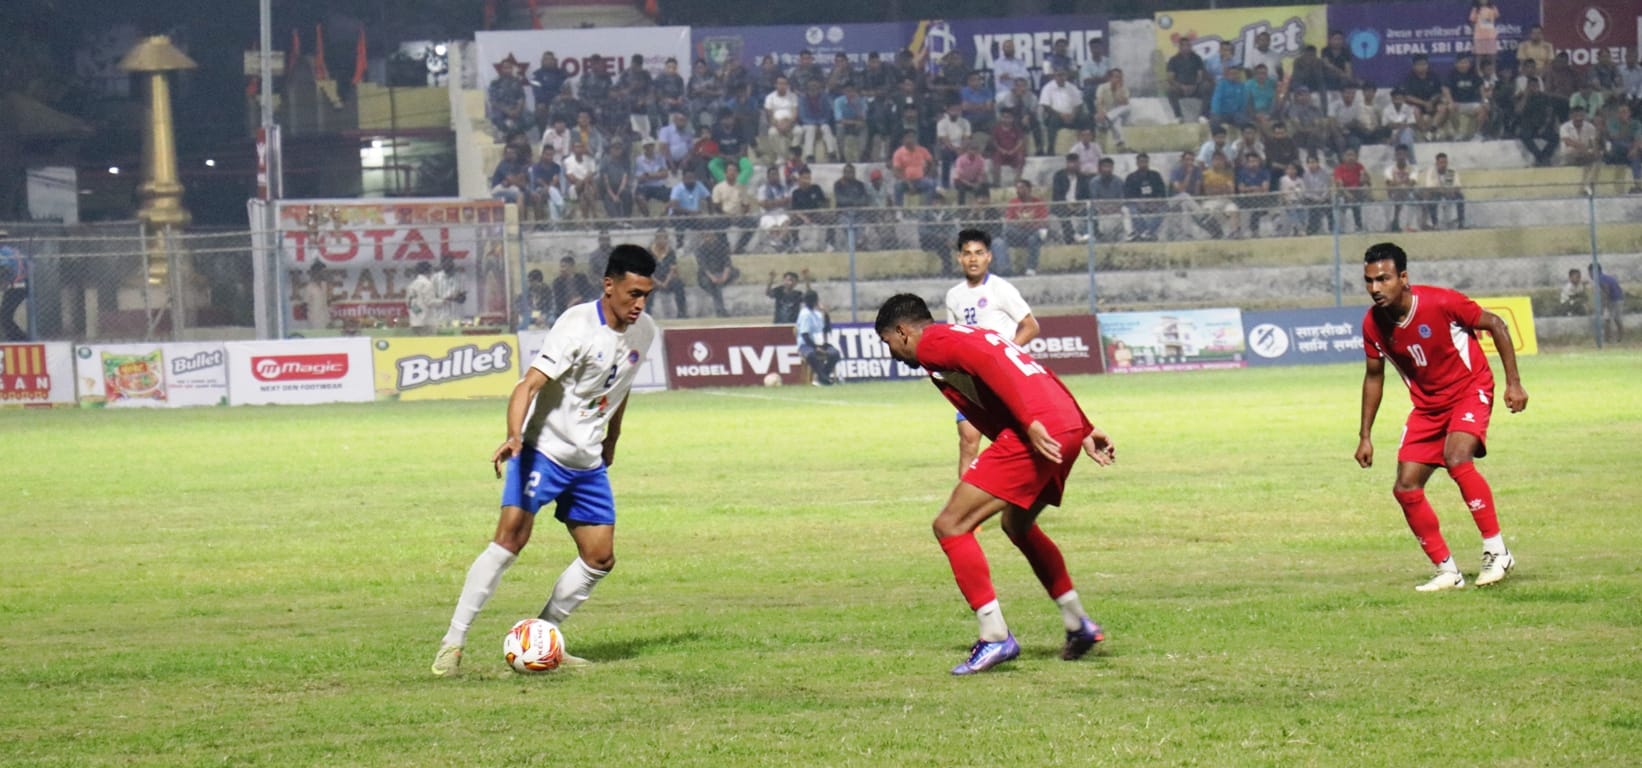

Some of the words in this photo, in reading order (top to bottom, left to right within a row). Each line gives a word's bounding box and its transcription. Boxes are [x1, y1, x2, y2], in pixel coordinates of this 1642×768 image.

[1191, 21, 1303, 69] Blet
[1386, 43, 1428, 55] NEPAL
[1431, 42, 1451, 53] SBI
[560, 56, 626, 77] OBEL
[284, 227, 471, 262] TOTAL
[964, 307, 977, 325] 22
[828, 328, 892, 358] XTR
[173, 351, 222, 375] Bullet
[399, 343, 513, 390] Bullet
[729, 346, 801, 375] IVF
[1407, 344, 1428, 367] 10
[603, 364, 618, 388] 2
[676, 364, 728, 377] NOBEL
[831, 359, 892, 378] NERGY
[0, 377, 48, 390] AN
[524, 471, 541, 497] 2
